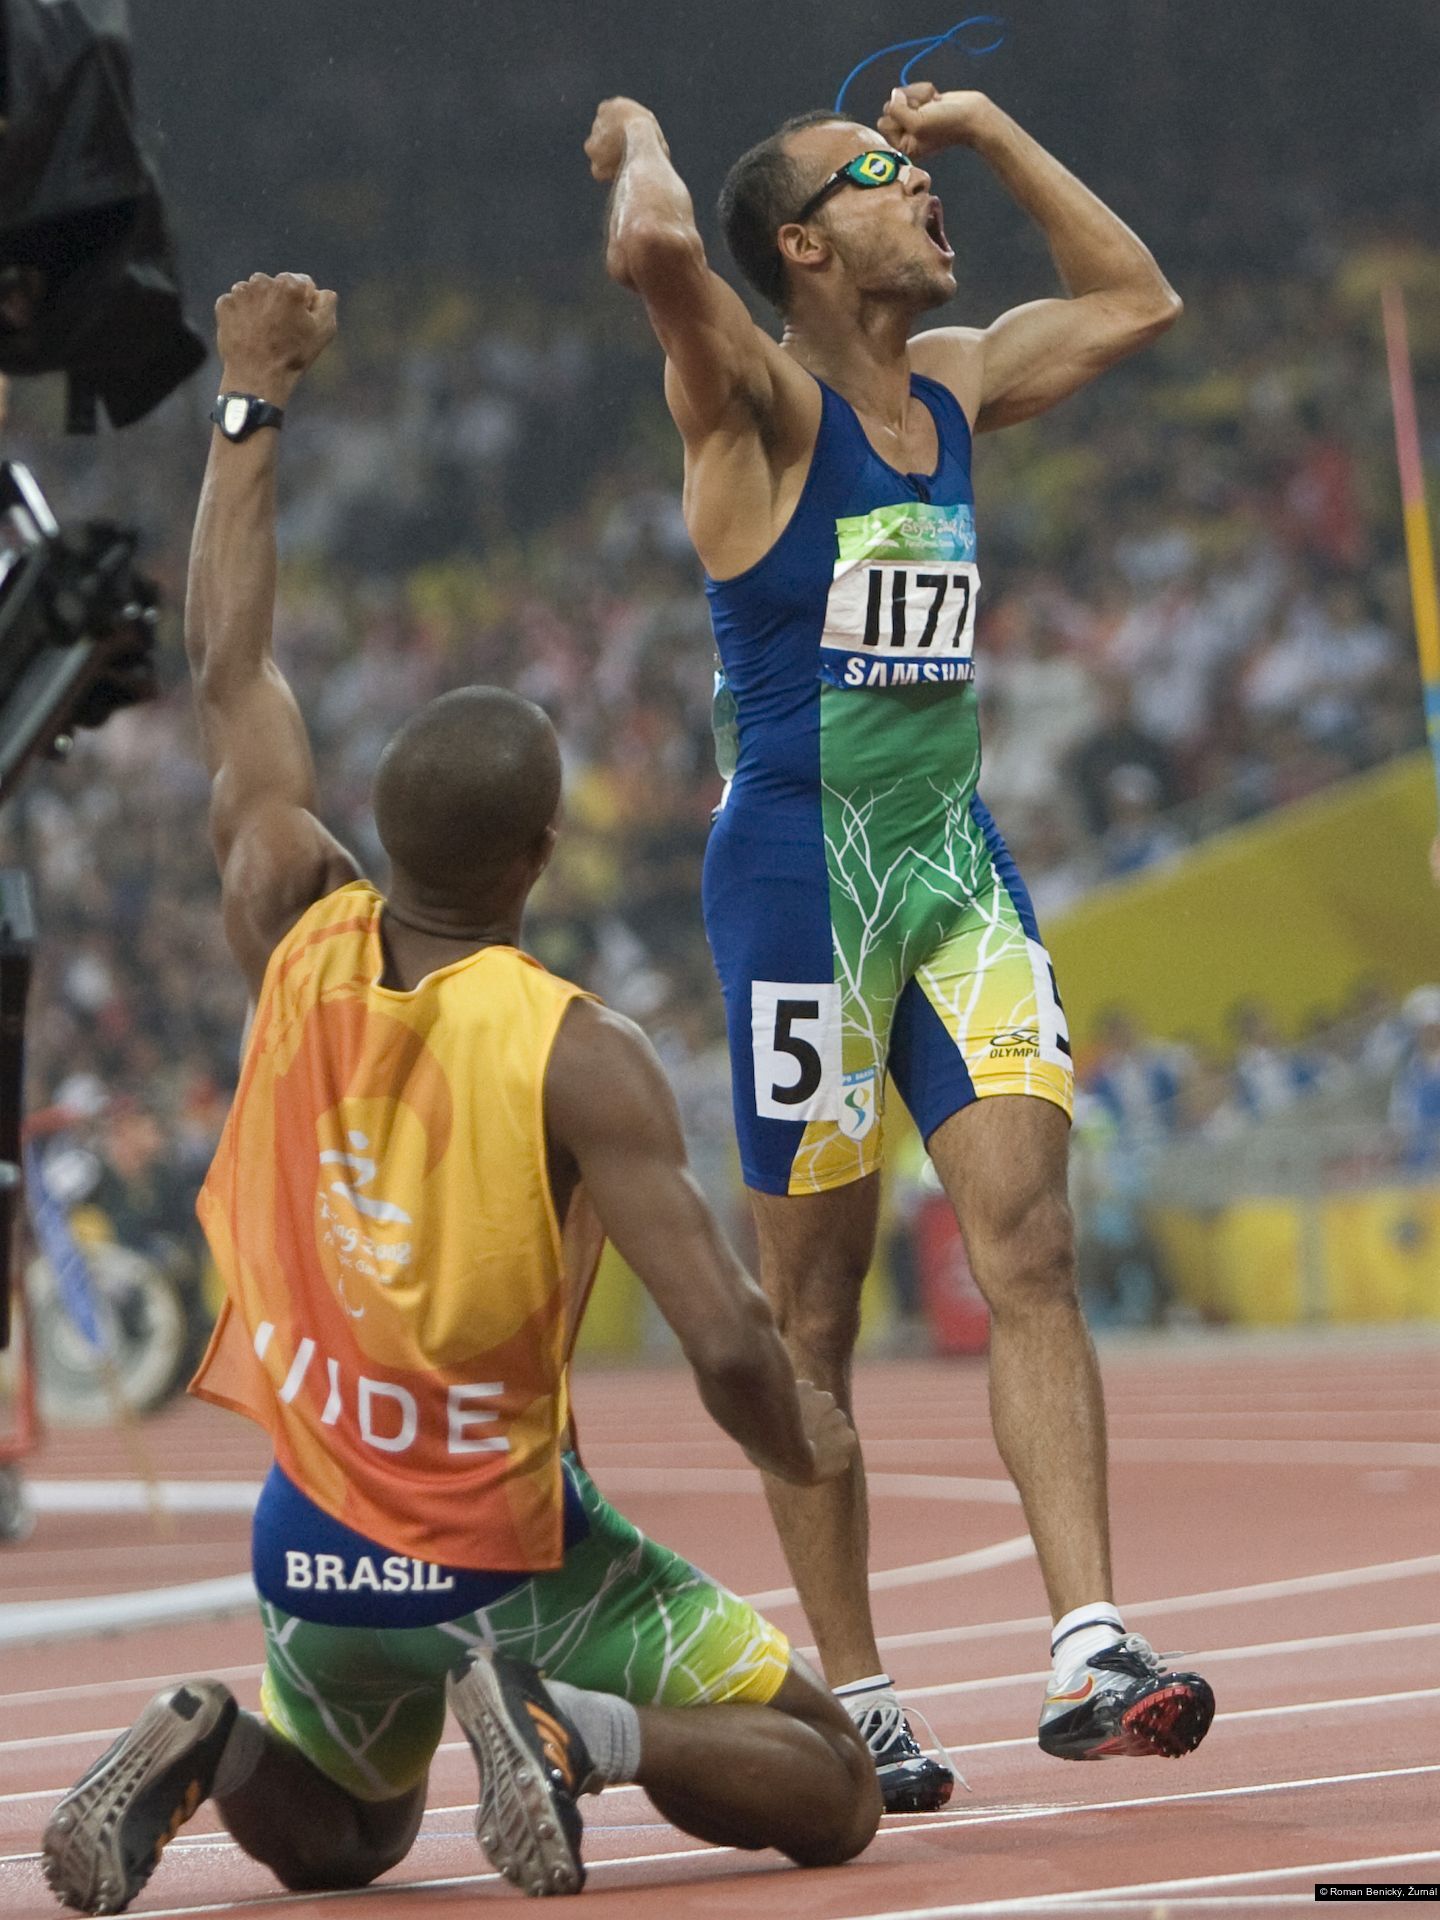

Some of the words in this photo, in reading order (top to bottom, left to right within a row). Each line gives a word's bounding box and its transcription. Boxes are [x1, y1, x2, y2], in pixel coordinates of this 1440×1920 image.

[863, 569, 970, 648] 1177
[771, 999, 822, 1105] 5
[285, 1551, 455, 1593] BRASIL
